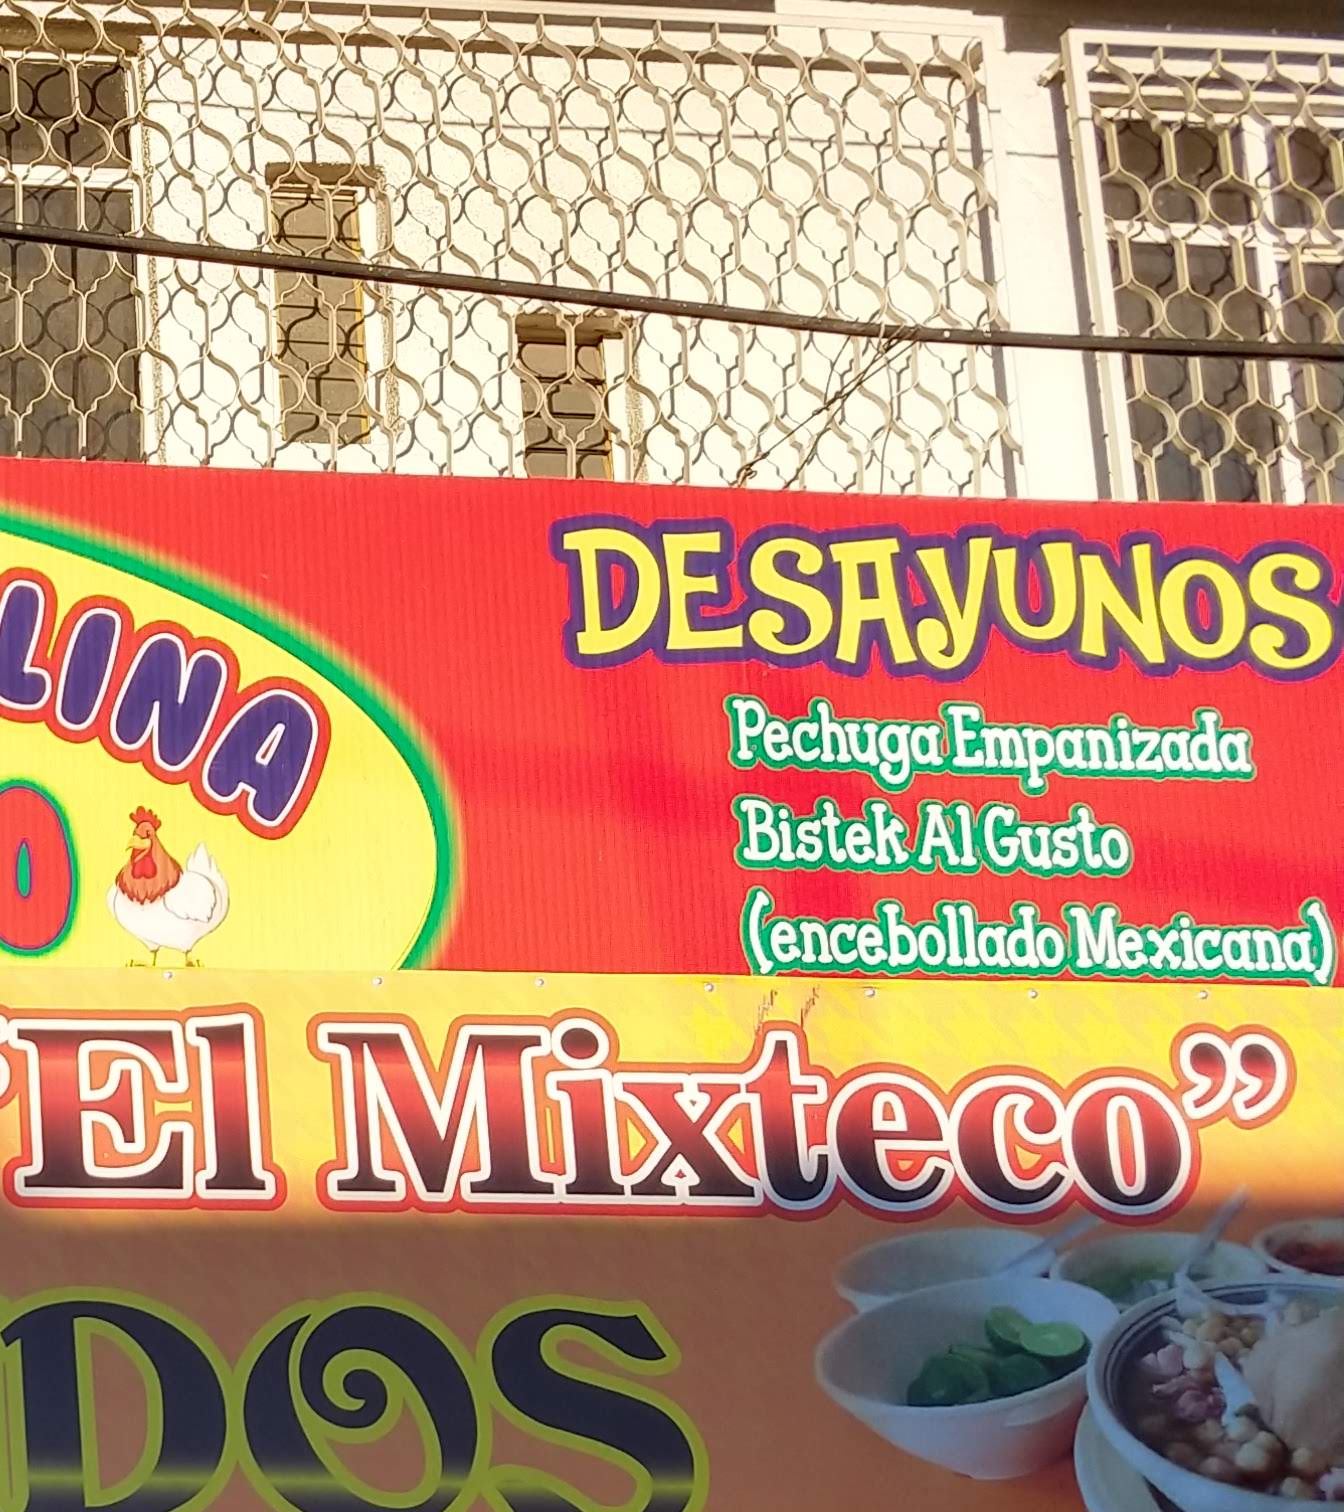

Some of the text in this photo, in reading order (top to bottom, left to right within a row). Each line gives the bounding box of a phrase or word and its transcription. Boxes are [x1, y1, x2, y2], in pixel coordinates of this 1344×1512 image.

[558, 521, 1338, 677] DESAYUNOS
[731, 696, 1253, 788] Pechuga Empanizada
[739, 798, 1131, 873] Bistek Al Gusto
[746, 889, 1335, 985] (encebollado Mexicana)
